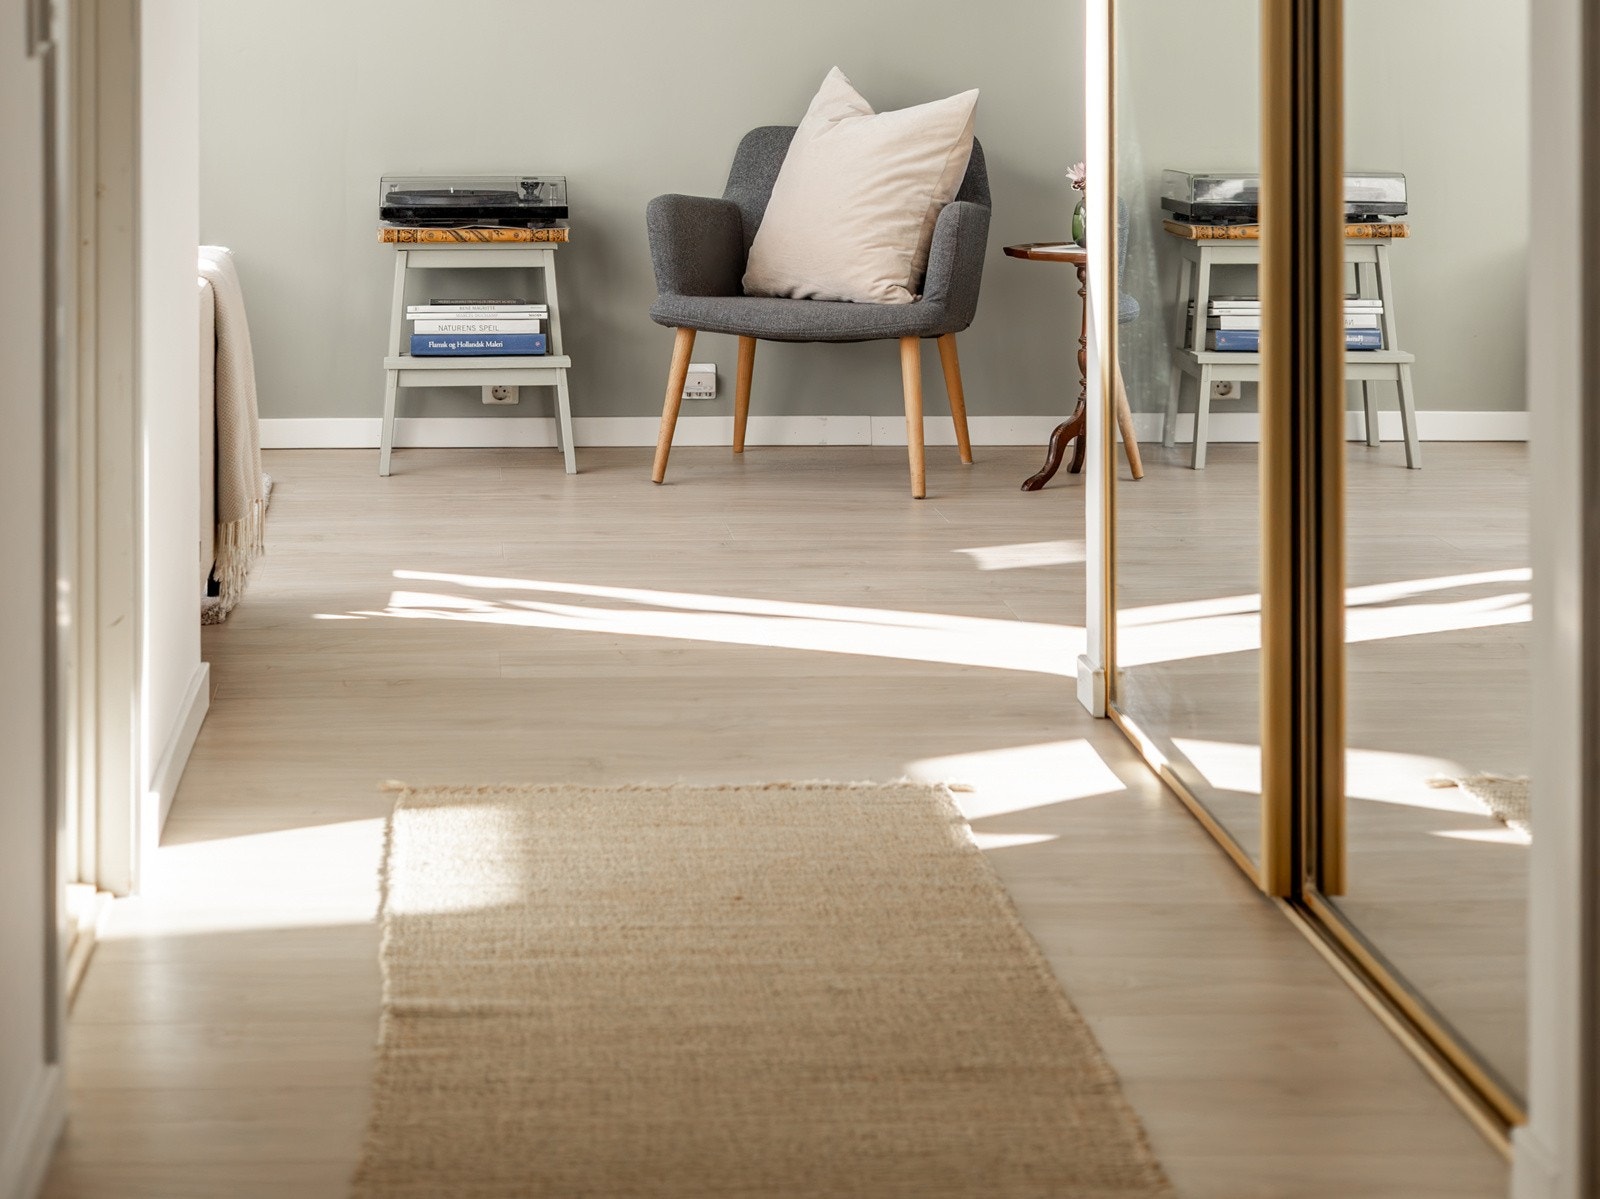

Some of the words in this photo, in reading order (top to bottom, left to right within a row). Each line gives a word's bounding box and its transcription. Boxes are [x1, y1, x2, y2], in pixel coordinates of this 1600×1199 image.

[438, 324, 476, 332] NATURENS
[479, 324, 499, 332] SPEIL
[428, 340, 448, 348] Flamsk
[457, 340, 484, 348] Hollandsk
[485, 340, 504, 348] Maleri
